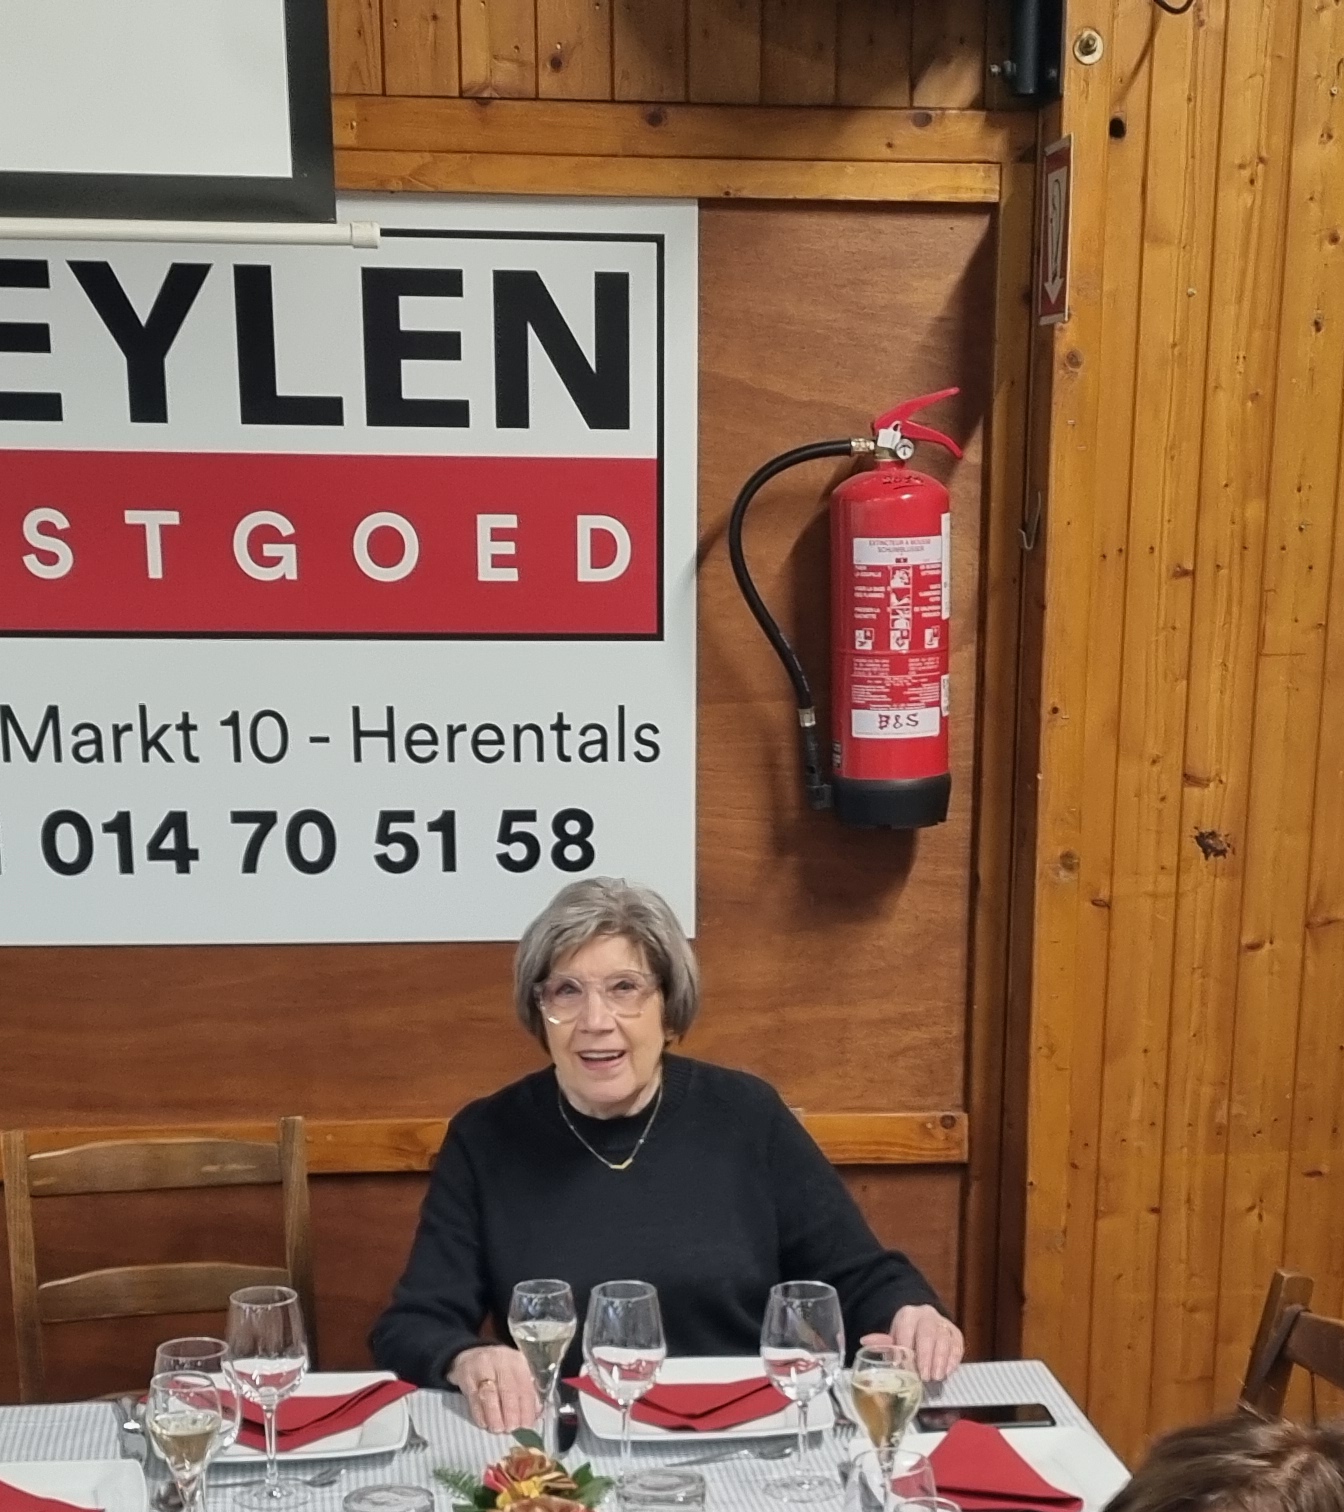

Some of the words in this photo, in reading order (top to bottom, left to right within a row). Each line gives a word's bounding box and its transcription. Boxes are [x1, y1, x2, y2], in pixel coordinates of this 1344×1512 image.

[1, 703, 200, 765] Markt
[218, 706, 291, 765] 10
[351, 702, 663, 767] Herentals
[40, 808, 200, 877] 014
[230, 808, 337, 876] 70
[372, 808, 459, 875] 51
[494, 807, 597, 876] 58
